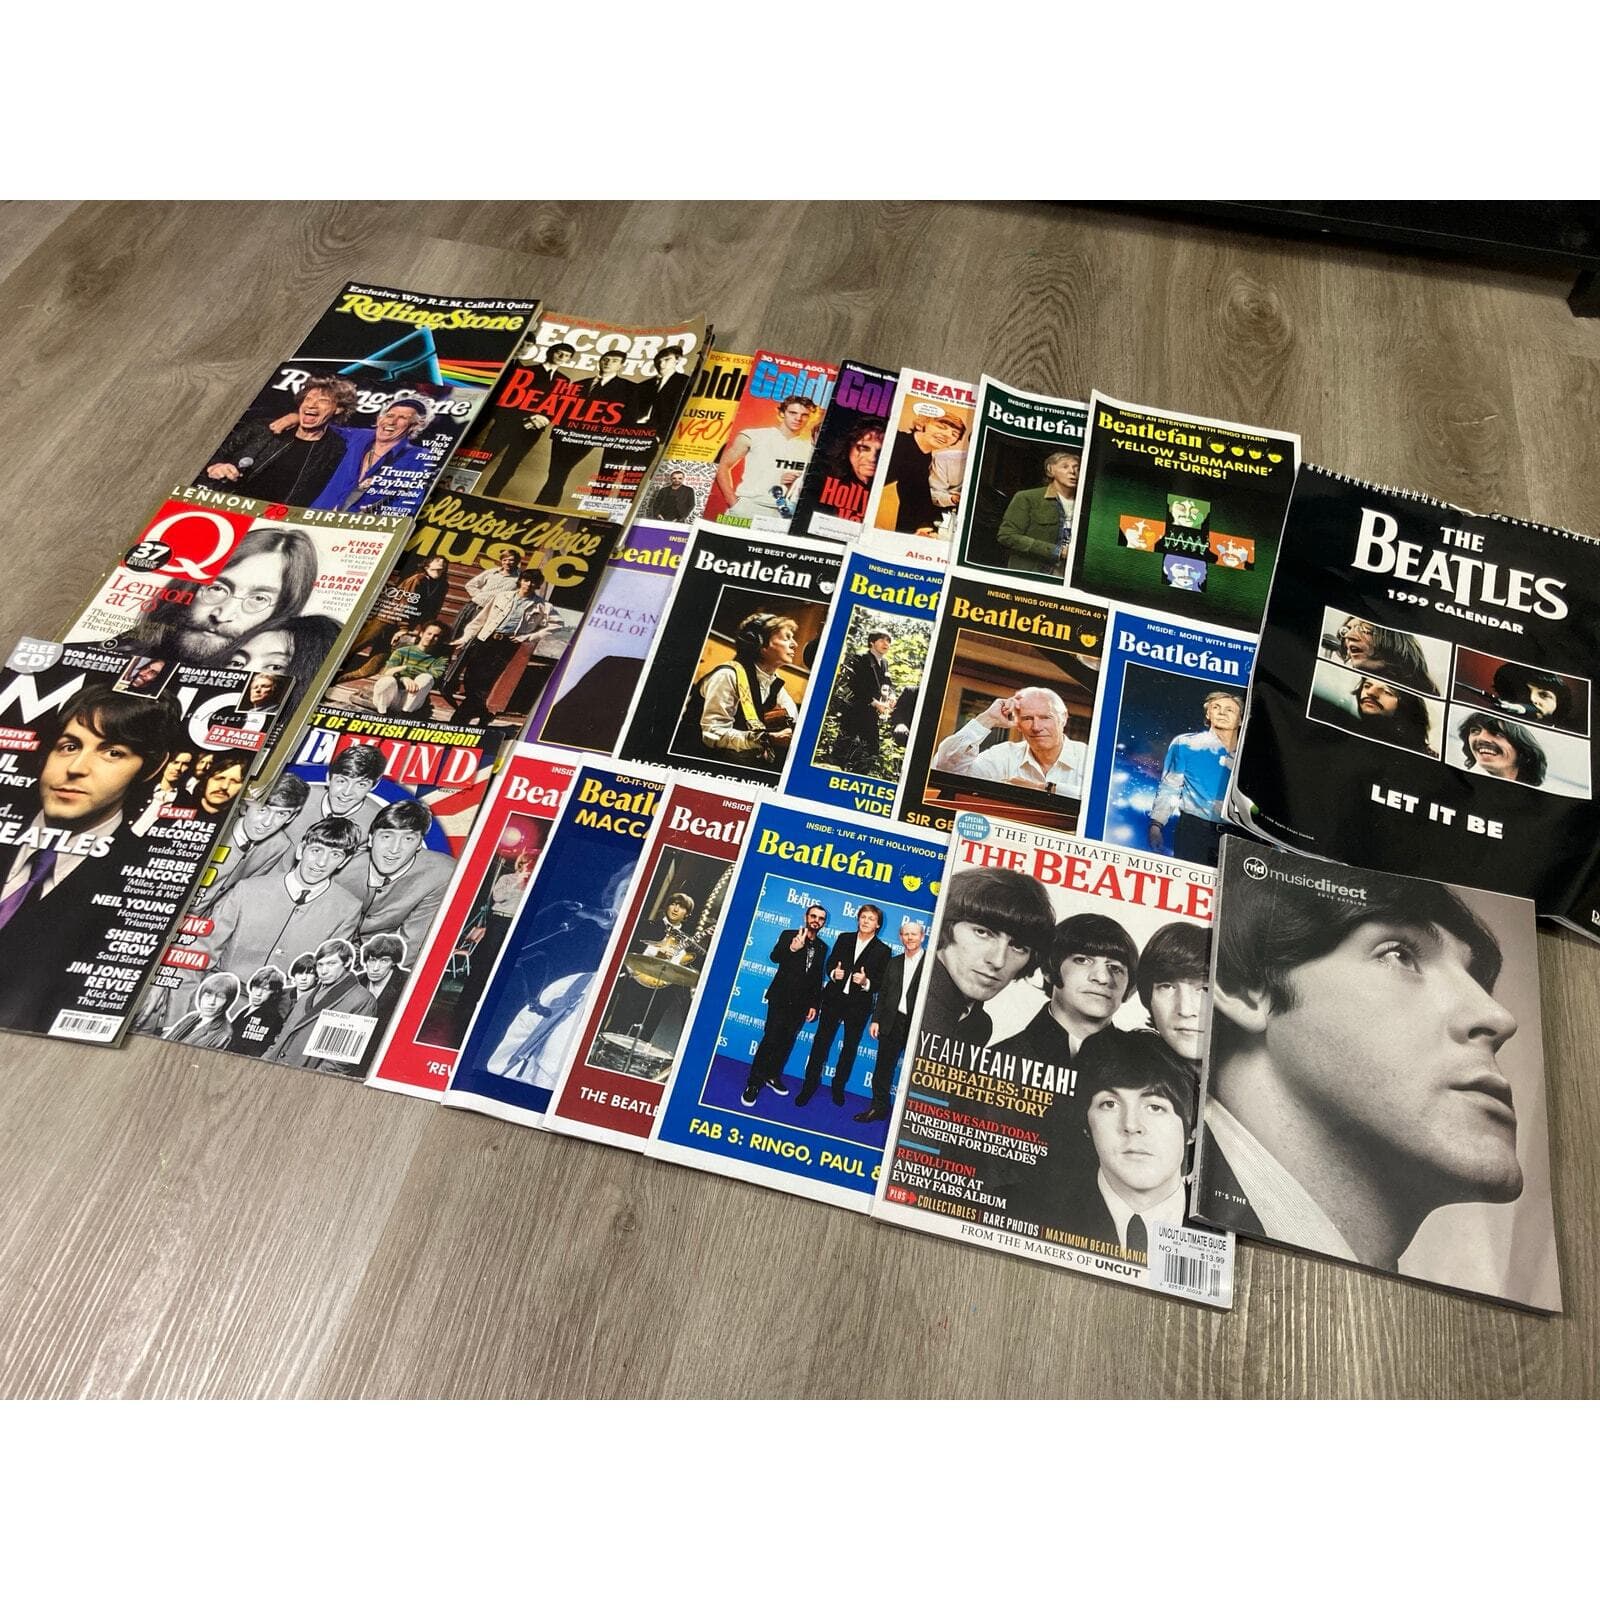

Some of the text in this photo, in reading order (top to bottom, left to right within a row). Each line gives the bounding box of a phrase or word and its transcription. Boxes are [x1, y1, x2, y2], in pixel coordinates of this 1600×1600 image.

[348, 286, 400, 299] Exclusive:
[402, 294, 425, 305] Why
[427, 298, 462, 308] R.E.M.
[464, 301, 496, 310] Called
[507, 302, 534, 310] Quits
[775, 358, 803, 369] YEARS
[553, 379, 583, 396] THE
[497, 368, 624, 425] BEATLES
[1034, 403, 1064, 416] GETTING
[602, 426, 656, 437] BEGINNING
[1098, 411, 1202, 449] Beatlefan
[1158, 418, 1196, 430] INTERVIEW
[1218, 429, 1240, 438] RINGO
[422, 440, 449, 448] Who's
[435, 434, 453, 442] The
[415, 452, 442, 461] Plans
[776, 459, 805, 470] THE
[380, 466, 432, 480] Trump's
[1154, 458, 1226, 480] RETURNS!
[371, 475, 427, 490] Payback
[172, 486, 256, 511] LENNON
[302, 510, 402, 528] BIRTHDAY
[143, 511, 235, 579] Q
[348, 540, 384, 548] KINGS
[1440, 526, 1486, 552] THE
[132, 542, 170, 560] 37
[350, 548, 380, 556] LEON
[748, 546, 824, 564] THE BEST OF APPLE
[695, 550, 812, 589] Beatlefan
[1351, 507, 1568, 620] BEATLES
[320, 574, 364, 584] DAMON
[869, 564, 924, 582] INSIDE: MACCA
[110, 575, 194, 605] Lennon
[312, 580, 360, 592] ALBARN
[594, 604, 632, 620] ROCK
[988, 590, 1092, 618] INSIDE: WINGS OVER AMERICA
[1387, 588, 1524, 635] 1999 CALENDAR
[588, 617, 624, 634] HALL
[952, 598, 1071, 641] Beatlefan
[1147, 624, 1242, 650] INSIDE: MORE WITH SIR
[18, 642, 54, 654] FREE
[1118, 630, 1240, 676] Beatlefan
[13, 653, 54, 668] CD!
[62, 658, 123, 674] UNSEEN!
[64, 650, 86, 660] BOB
[86, 652, 129, 666] MARLEY
[178, 667, 248, 681] BRIAN WILSON
[180, 674, 238, 688] SPEAKS!
[320, 708, 356, 718] CLARK FIVE
[326, 716, 347, 729] OF
[829, 776, 895, 800] BEATLES
[160, 809, 194, 818] PLUS!
[906, 812, 930, 826] SIR
[964, 816, 984, 825] SPECIAL
[1371, 784, 1504, 840] LET IT BE
[149, 827, 212, 844] RECORDS
[172, 820, 216, 834] APPLE
[964, 831, 983, 840] EDITION
[172, 840, 206, 852] The Full
[806, 822, 936, 859] INSIDE: AT THE HOLLYWOOD
[148, 845, 202, 860] Inside Story
[757, 828, 892, 884] Beatlefan
[961, 840, 1027, 875] THE
[994, 827, 1182, 878] THE ULTIMATE MUSIC
[148, 858, 197, 874] HERBIE
[120, 866, 192, 884] HANCOCK
[124, 886, 152, 896] Brown
[158, 882, 186, 892] James
[92, 894, 176, 914] NEIL YOUNG
[117, 908, 170, 922] Hometown
[124, 918, 167, 932] Triumph!
[105, 928, 159, 945] SHERYL
[178, 934, 196, 944] POP
[108, 941, 156, 957] CROW
[96, 952, 148, 966] Soul Sister
[168, 950, 205, 967] TRIVIA
[66, 962, 142, 981] JIM JONES
[84, 976, 136, 993] REVUE
[76, 996, 124, 1010] The Jams!
[84, 988, 128, 1002] Kick Out
[921, 1031, 1078, 1097] YEAH YEAH YEAH!
[916, 1057, 1054, 1106] THE BEATLES: THE
[580, 1086, 607, 1105] THE
[912, 1072, 1048, 1119] COMPLETE STORY
[908, 1100, 998, 1132] THINGS WE SAID
[904, 1110, 1048, 1157] INCREDIBLE INTERVIEWS
[690, 1118, 866, 1177] FAB 3: RINGO, PAUL
[911, 1124, 1037, 1166] UNSEEN FOR DECADES
[897, 1148, 976, 1177] REVOLUTION!
[904, 1162, 984, 1191] NEW LOOK AT
[892, 1170, 1006, 1209] EVERY FABS ALBUM
[1232, 1196, 1246, 1205] THE
[889, 1189, 1148, 1264] PLUS COLLECTABLES RARE PHOTOS MAXIMUM BEATLEMANIA
[960, 1224, 1142, 1278] FROM THE MAKERS OF UNCUT
[1208, 1238, 1226, 1250] GUIDE
